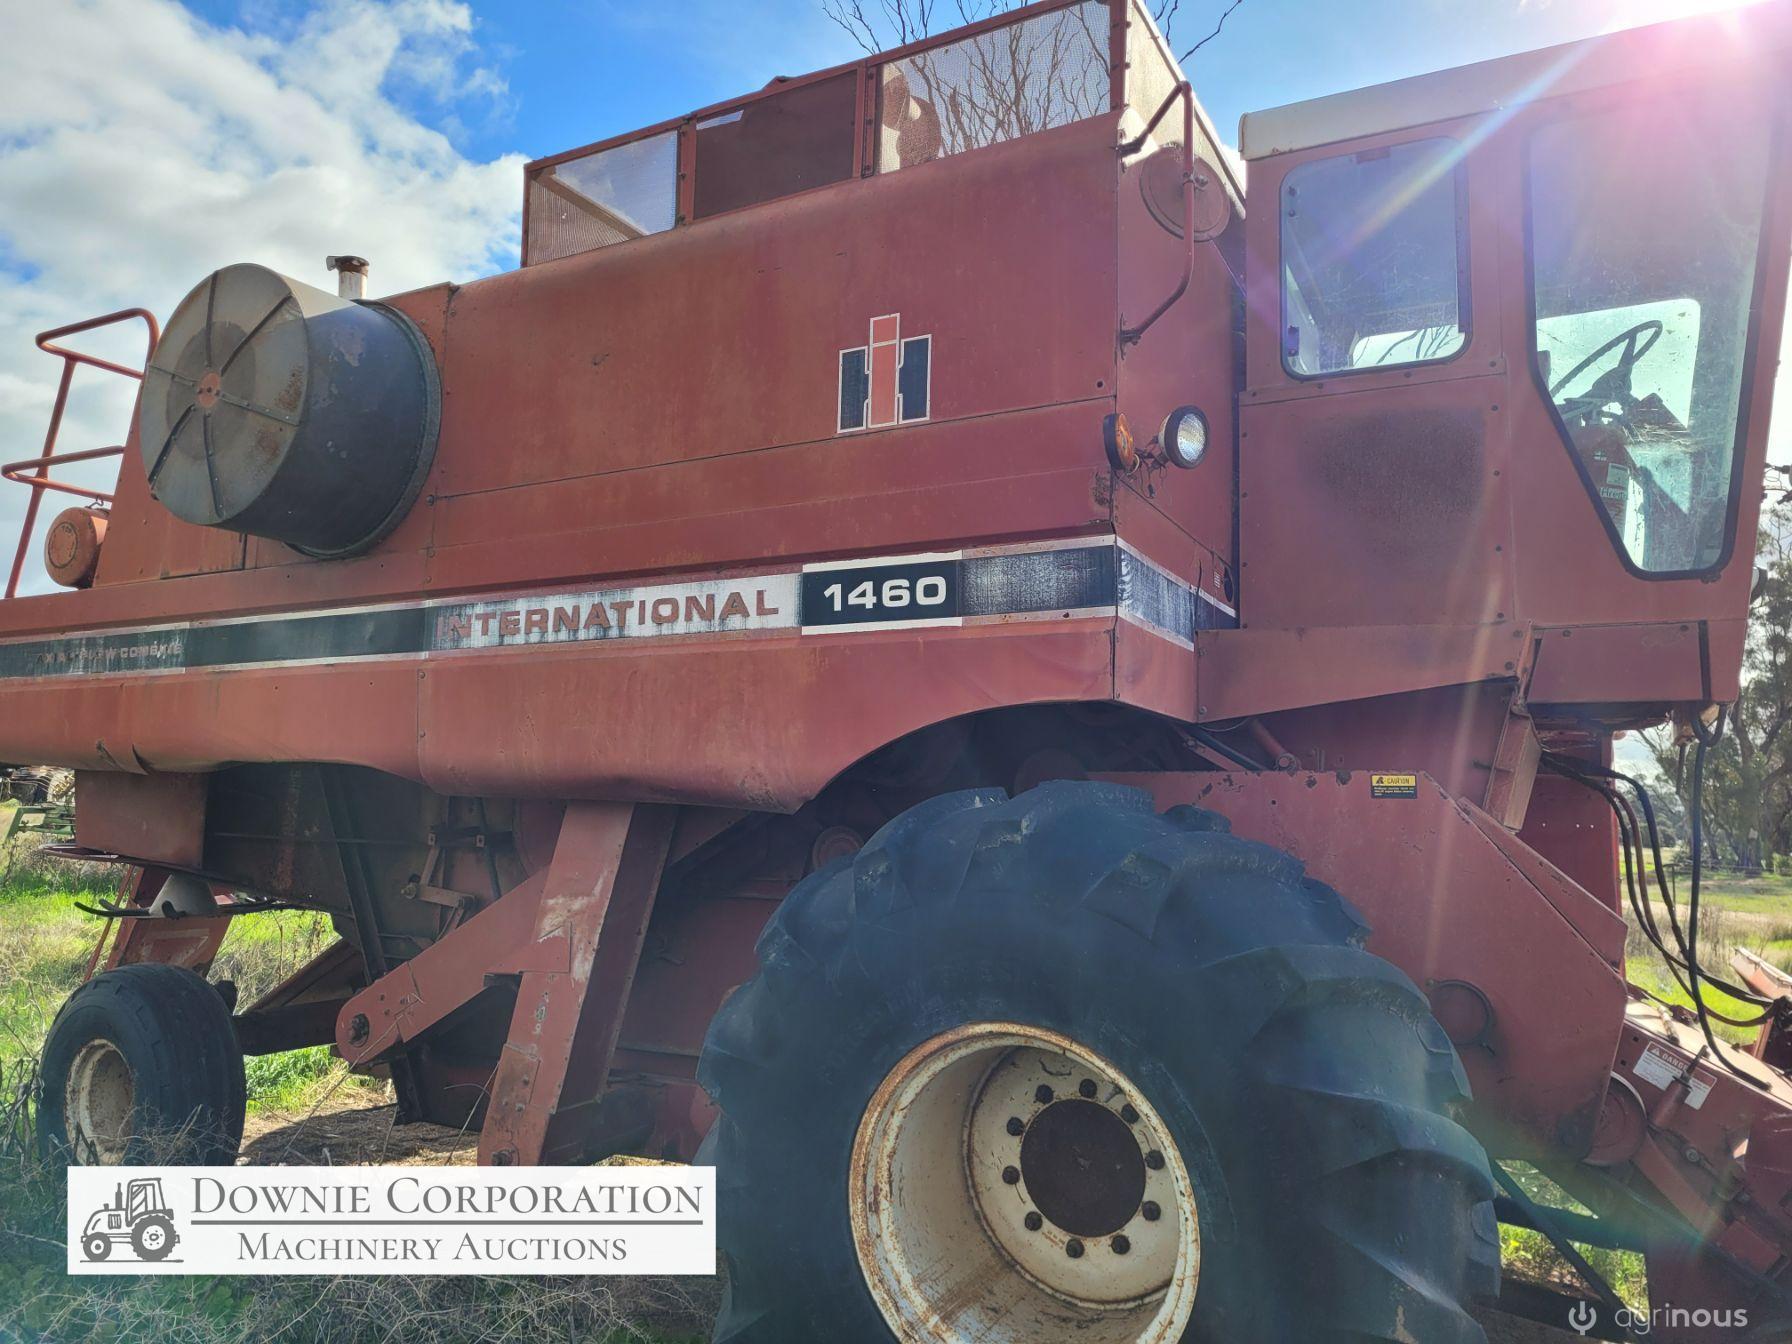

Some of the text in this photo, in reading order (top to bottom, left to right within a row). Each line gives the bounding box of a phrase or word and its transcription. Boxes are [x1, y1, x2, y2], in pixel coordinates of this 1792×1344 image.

[823, 576, 947, 612] 1460
[437, 589, 779, 639] INTERNATIONAL
[1661, 1053, 1689, 1070] DANGE
